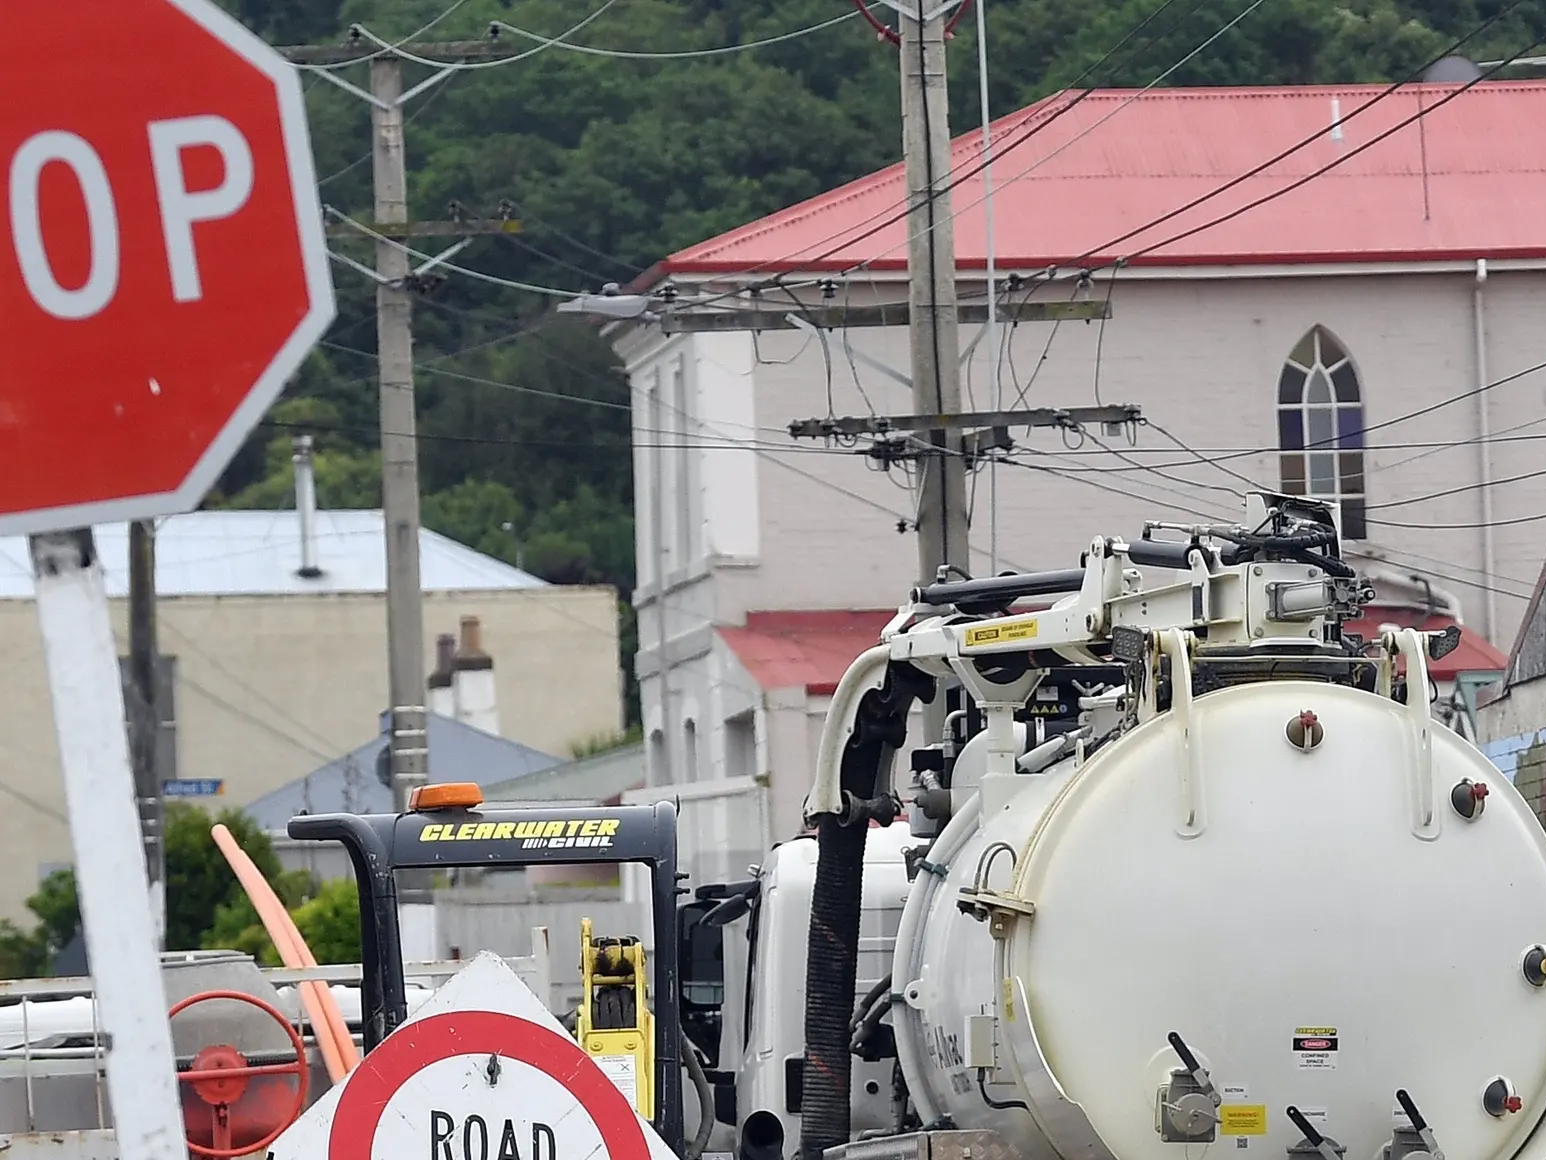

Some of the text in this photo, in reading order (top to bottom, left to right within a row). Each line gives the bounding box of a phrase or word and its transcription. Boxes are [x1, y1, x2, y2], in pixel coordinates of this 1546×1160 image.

[9, 114, 255, 320] OP
[419, 818, 621, 842] CLEARWATER
[547, 836, 614, 848] CIVIL
